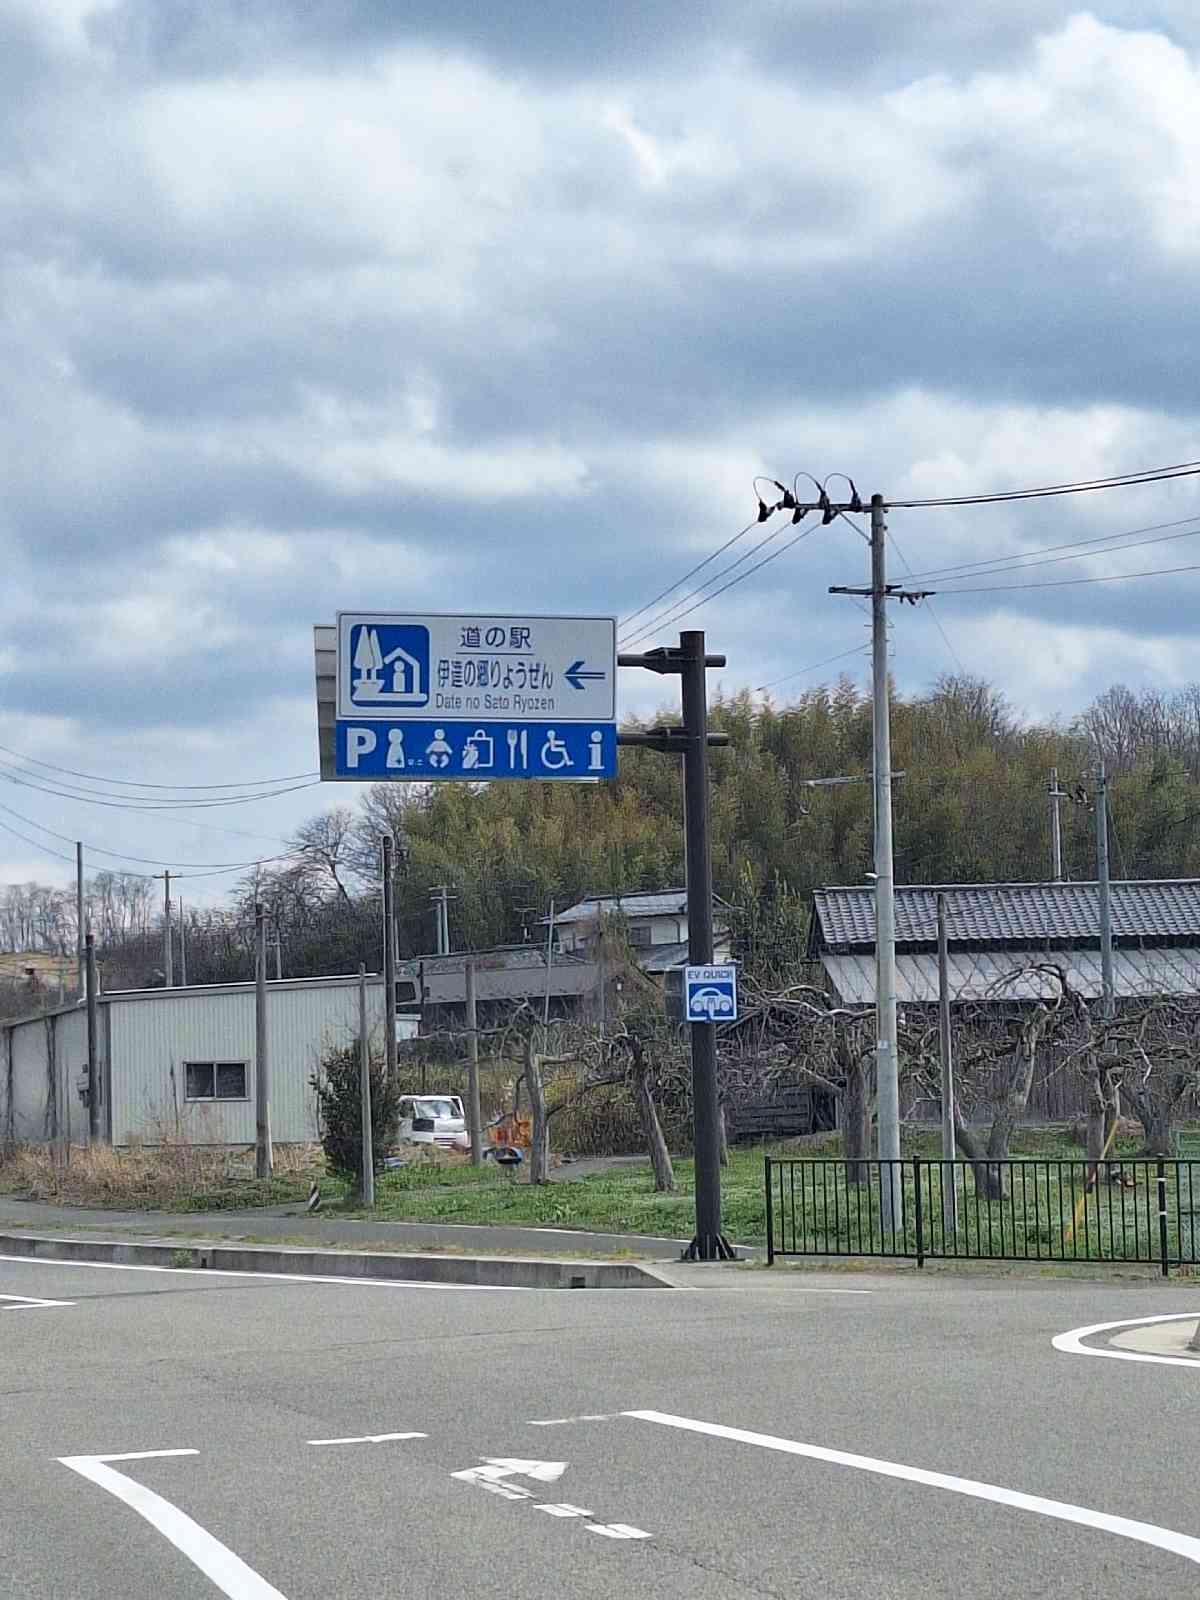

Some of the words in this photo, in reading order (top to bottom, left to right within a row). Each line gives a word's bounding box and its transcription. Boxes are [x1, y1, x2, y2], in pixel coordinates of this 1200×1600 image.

[460, 626, 531, 649] 道の駅
[436, 693, 462, 709] Date
[465, 697, 480, 709] no
[484, 694, 510, 710] Sato
[513, 695, 555, 712] Ryozen
[346, 727, 377, 768] P
